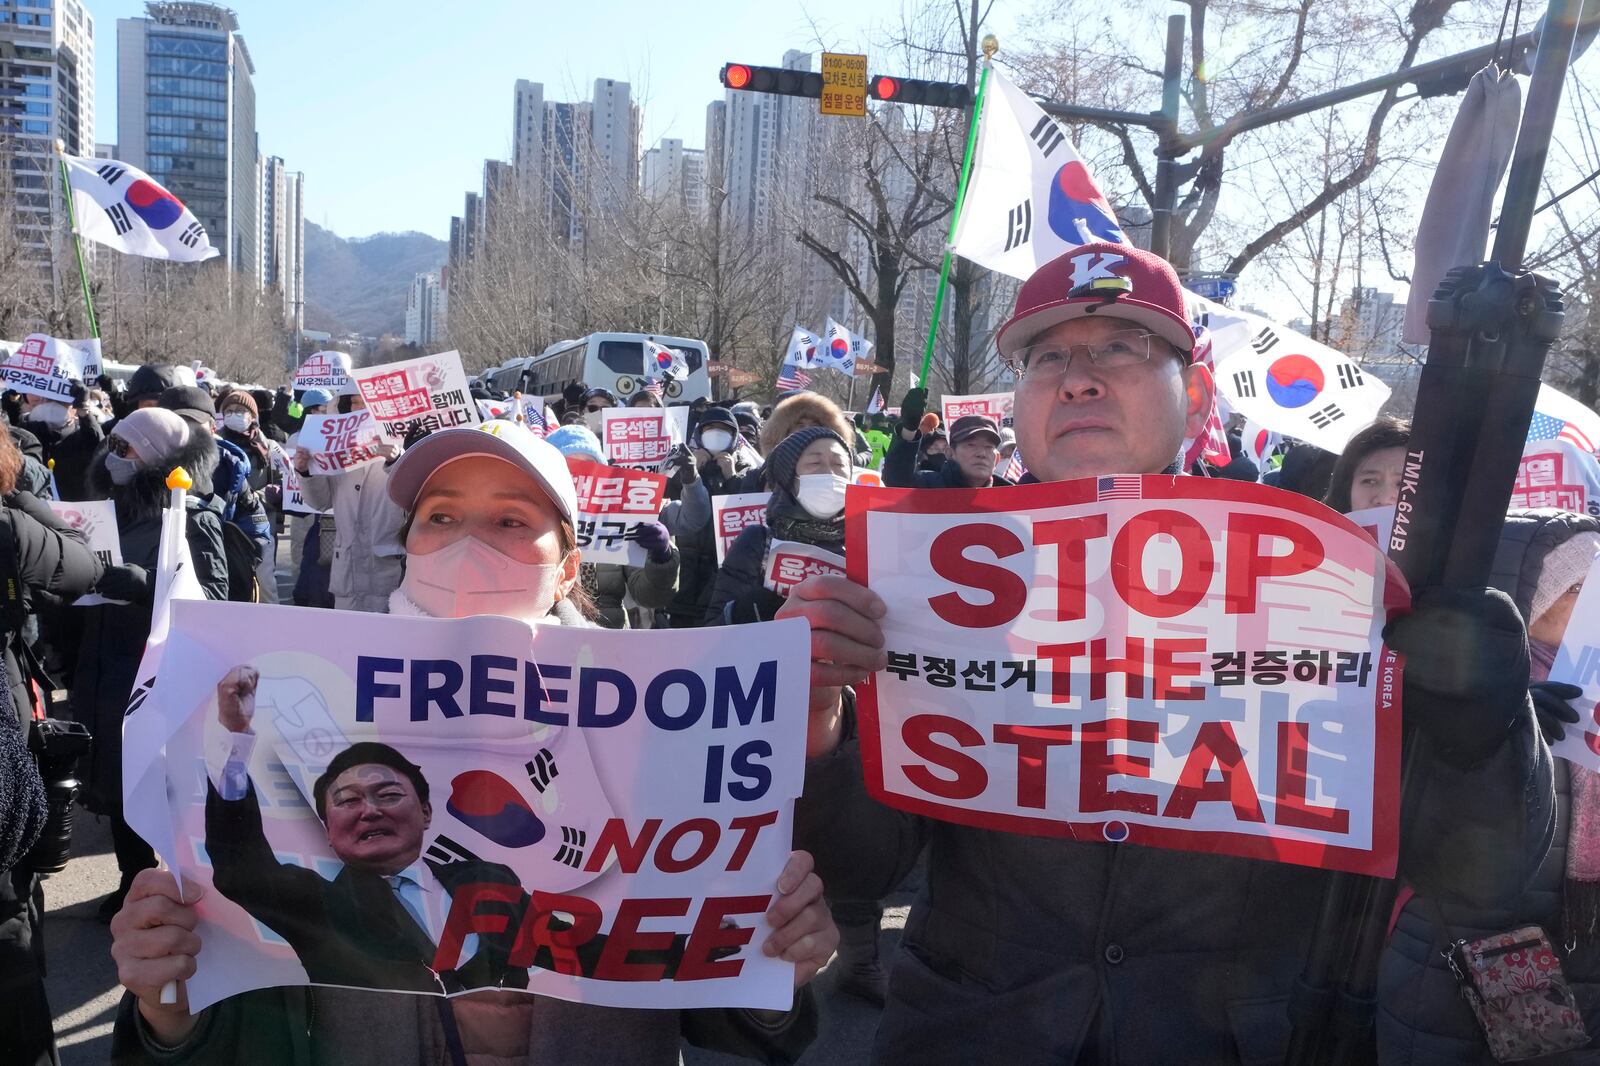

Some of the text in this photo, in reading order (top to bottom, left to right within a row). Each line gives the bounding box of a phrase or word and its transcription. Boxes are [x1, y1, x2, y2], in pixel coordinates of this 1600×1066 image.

[823, 71, 865, 88] 교차로신호
[823, 92, 864, 111] 점멸운영
[1068, 252, 1124, 290] K
[297, 377, 349, 387] 싸우겠습니다
[361, 375, 406, 400] 윤석열
[431, 389, 466, 410] 함께
[320, 412, 370, 435] STOP
[368, 392, 428, 418] 대통령과
[325, 429, 359, 452] THE
[610, 420, 659, 440] 윤석열
[1390, 450, 1425, 551] TMK-644B
[927, 509, 1325, 629] STOP
[8, 578, 16, 600] Nikon
[886, 650, 1037, 692] 부정선거
[1036, 636, 1208, 704] THE
[1210, 649, 1373, 688] 검증하라
[355, 654, 778, 731] FREEDOM
[1382, 667, 1394, 709] KOREA
[703, 740, 773, 804] IS
[900, 713, 1350, 834] STEAL
[583, 810, 779, 874] NOT
[432, 883, 773, 982] FREE
